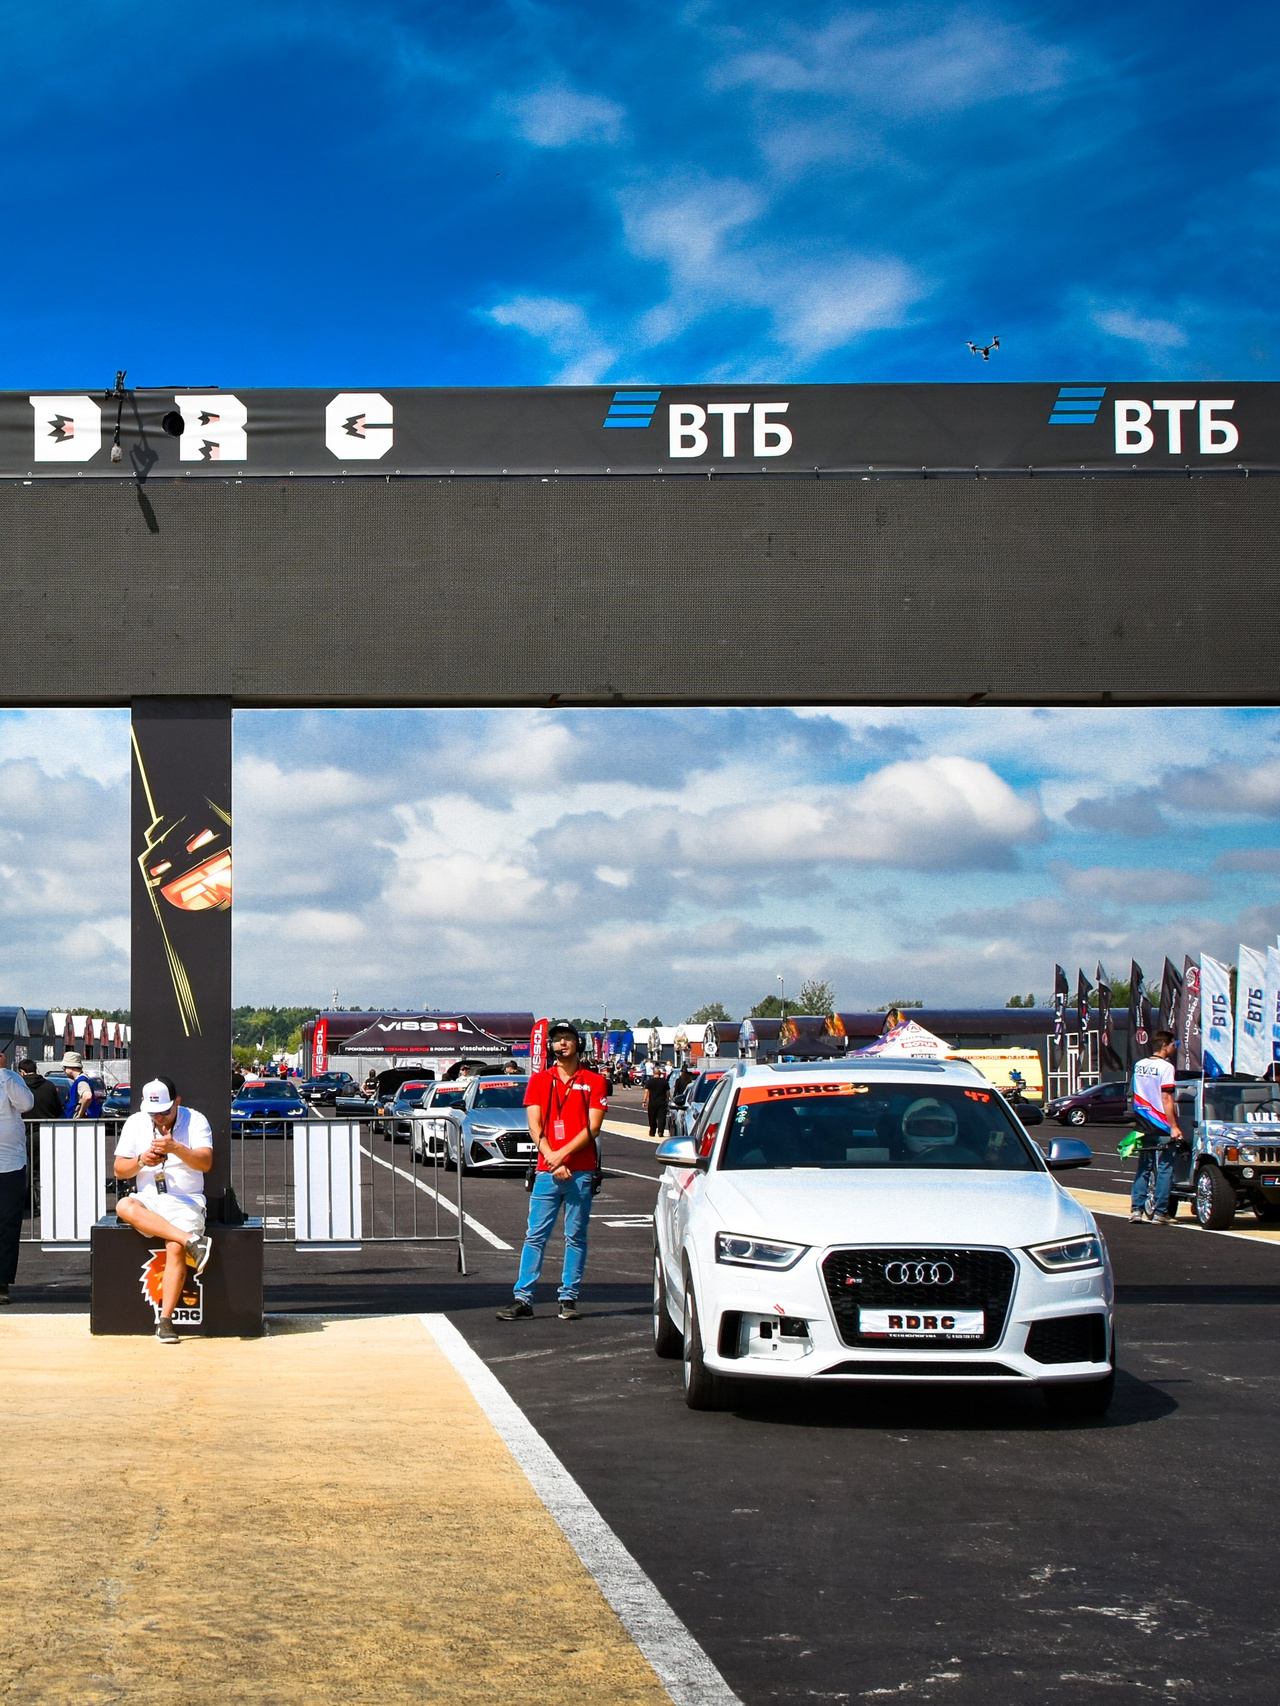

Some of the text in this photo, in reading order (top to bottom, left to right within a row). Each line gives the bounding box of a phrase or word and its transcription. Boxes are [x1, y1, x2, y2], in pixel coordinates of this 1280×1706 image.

[669, 402, 793, 458] ВТБ
[1114, 400, 1240, 455] ВТБ
[1212, 994, 1227, 1028] ВТБ
[1247, 987, 1264, 1023] ВТБ
[767, 1084, 840, 1097] RDRC
[964, 1090, 992, 1104] 47
[159, 1310, 200, 1320] DRC
[888, 1315, 955, 1330] RDRC
